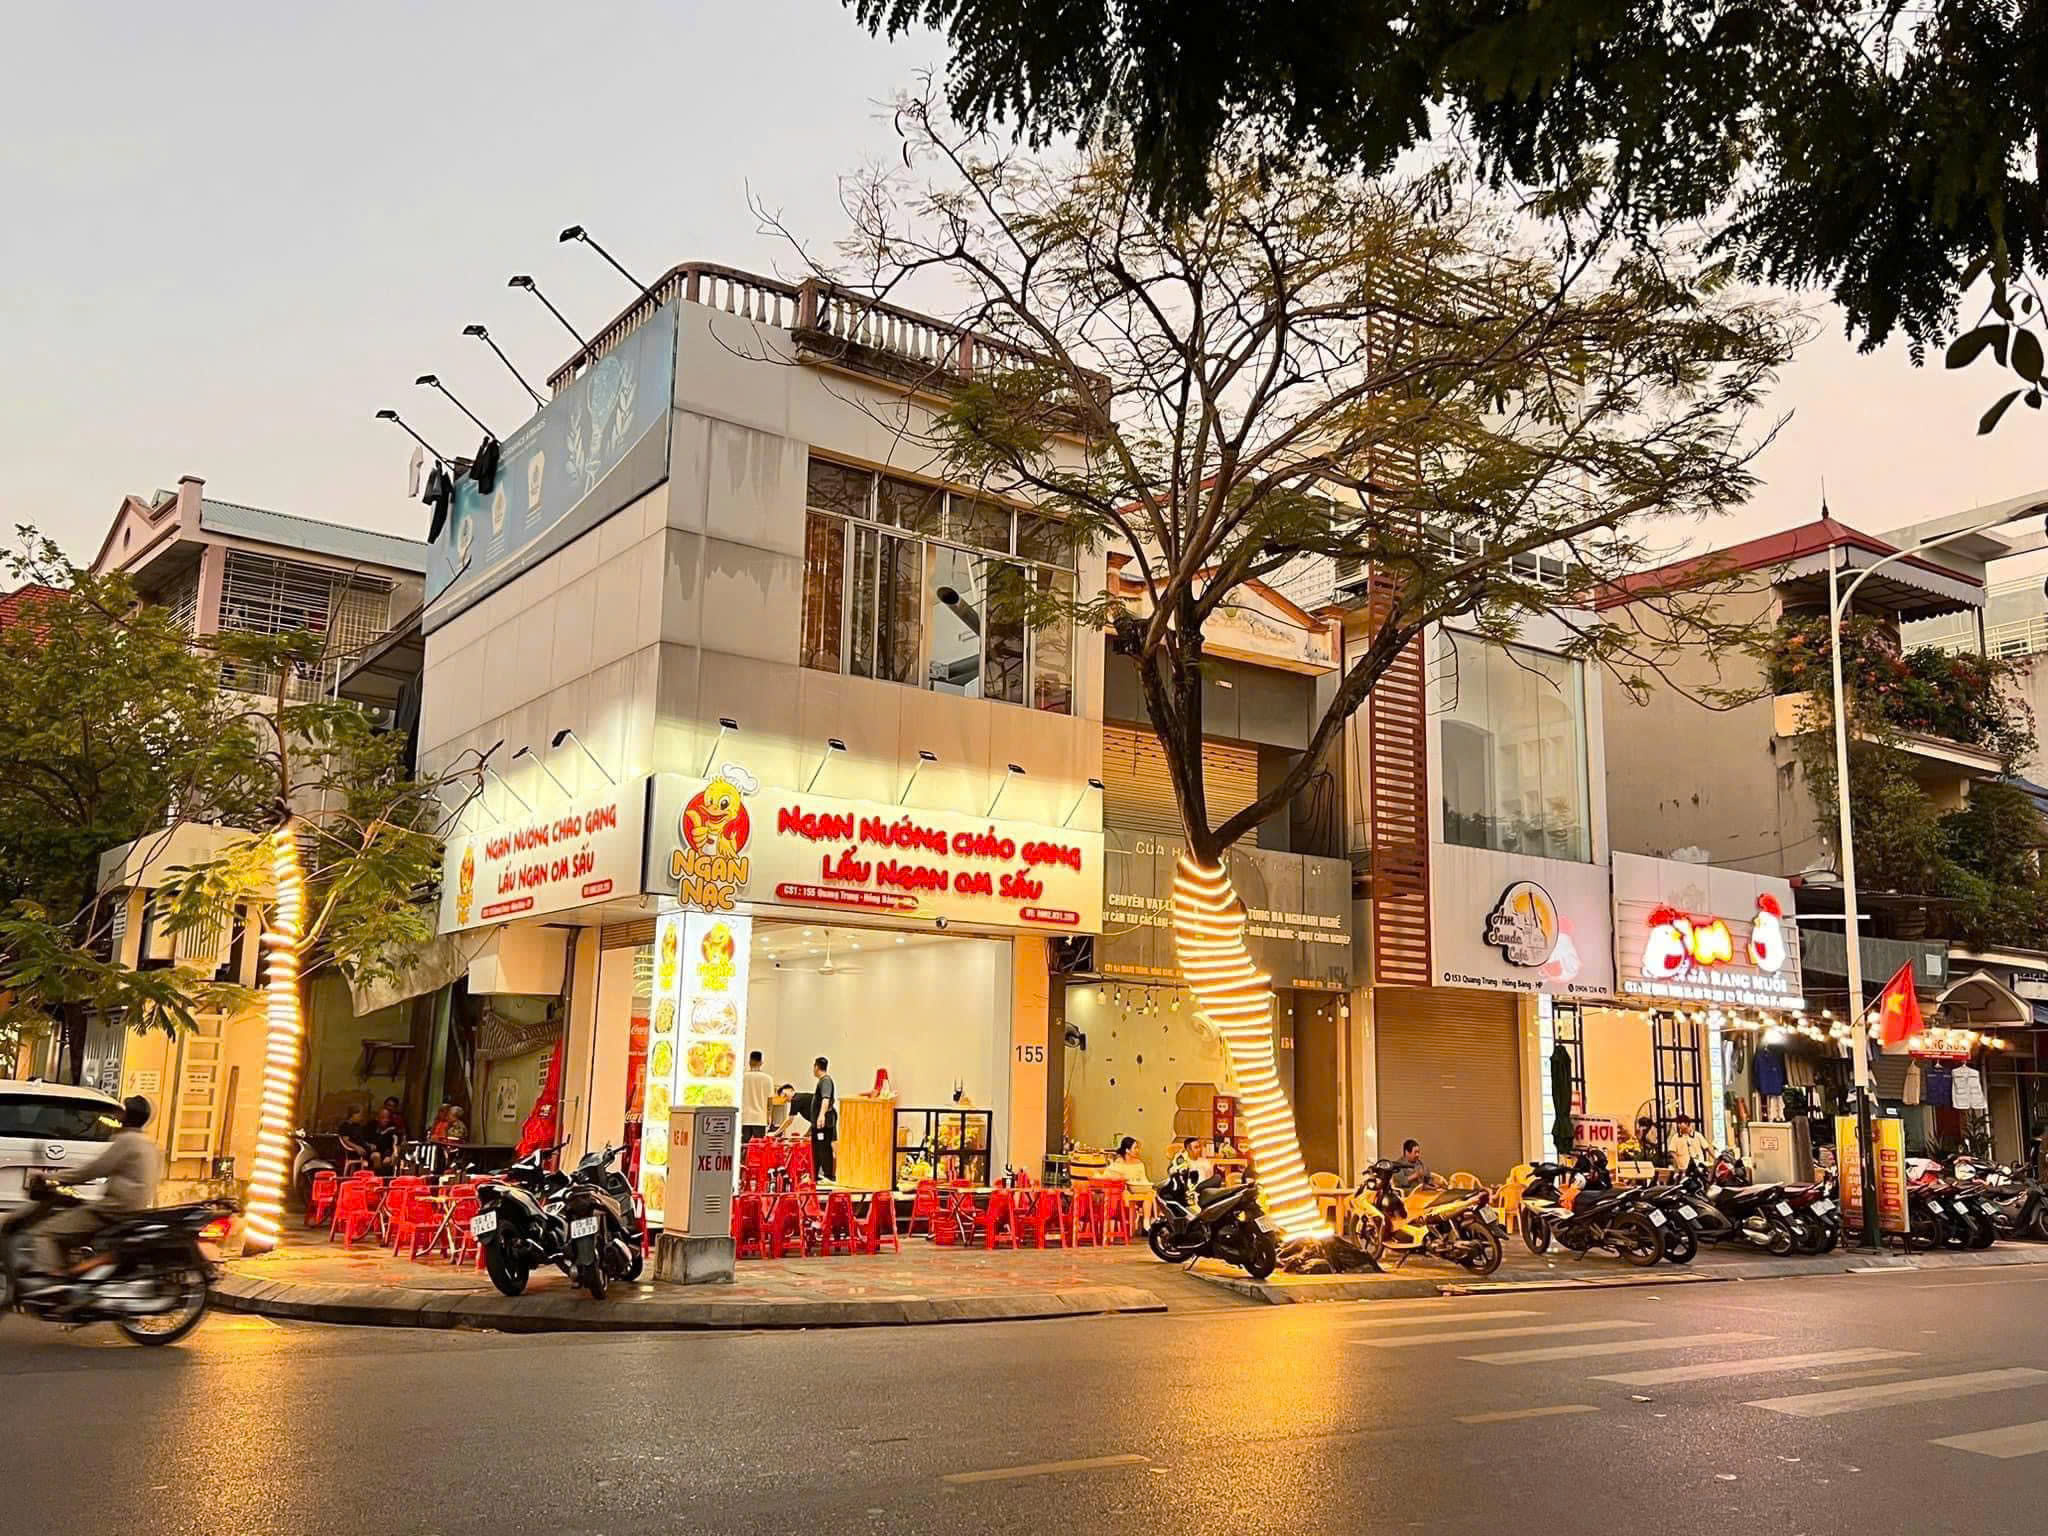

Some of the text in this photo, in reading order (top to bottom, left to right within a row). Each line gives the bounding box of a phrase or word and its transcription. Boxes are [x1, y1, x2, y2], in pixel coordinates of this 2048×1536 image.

[485, 832, 511, 862] NGAN
[585, 804, 617, 833] GANG
[778, 805, 1082, 871] NGAN NƯỚNG CHẢO GANG
[518, 860, 548, 890] NGAN
[551, 854, 569, 882] OM
[672, 849, 749, 885] NGAN
[876, 858, 948, 891] NGAN
[954, 871, 993, 896] OM
[999, 867, 1043, 900] SẤU
[680, 878, 735, 912] NẠC
[803, 887, 816, 897] 155
[1108, 893, 1145, 909] CHUYÊN
[1492, 907, 1515, 926] Am
[1451, 974, 1462, 983] 153
[1462, 975, 1481, 985] Quang
[1482, 976, 1498, 987] Trung
[1711, 969, 1750, 988] RANG
[1016, 1045, 1043, 1063] 155
[1589, 1124, 1613, 1142] HƠI
[697, 1151, 732, 1172] XE ÔM
